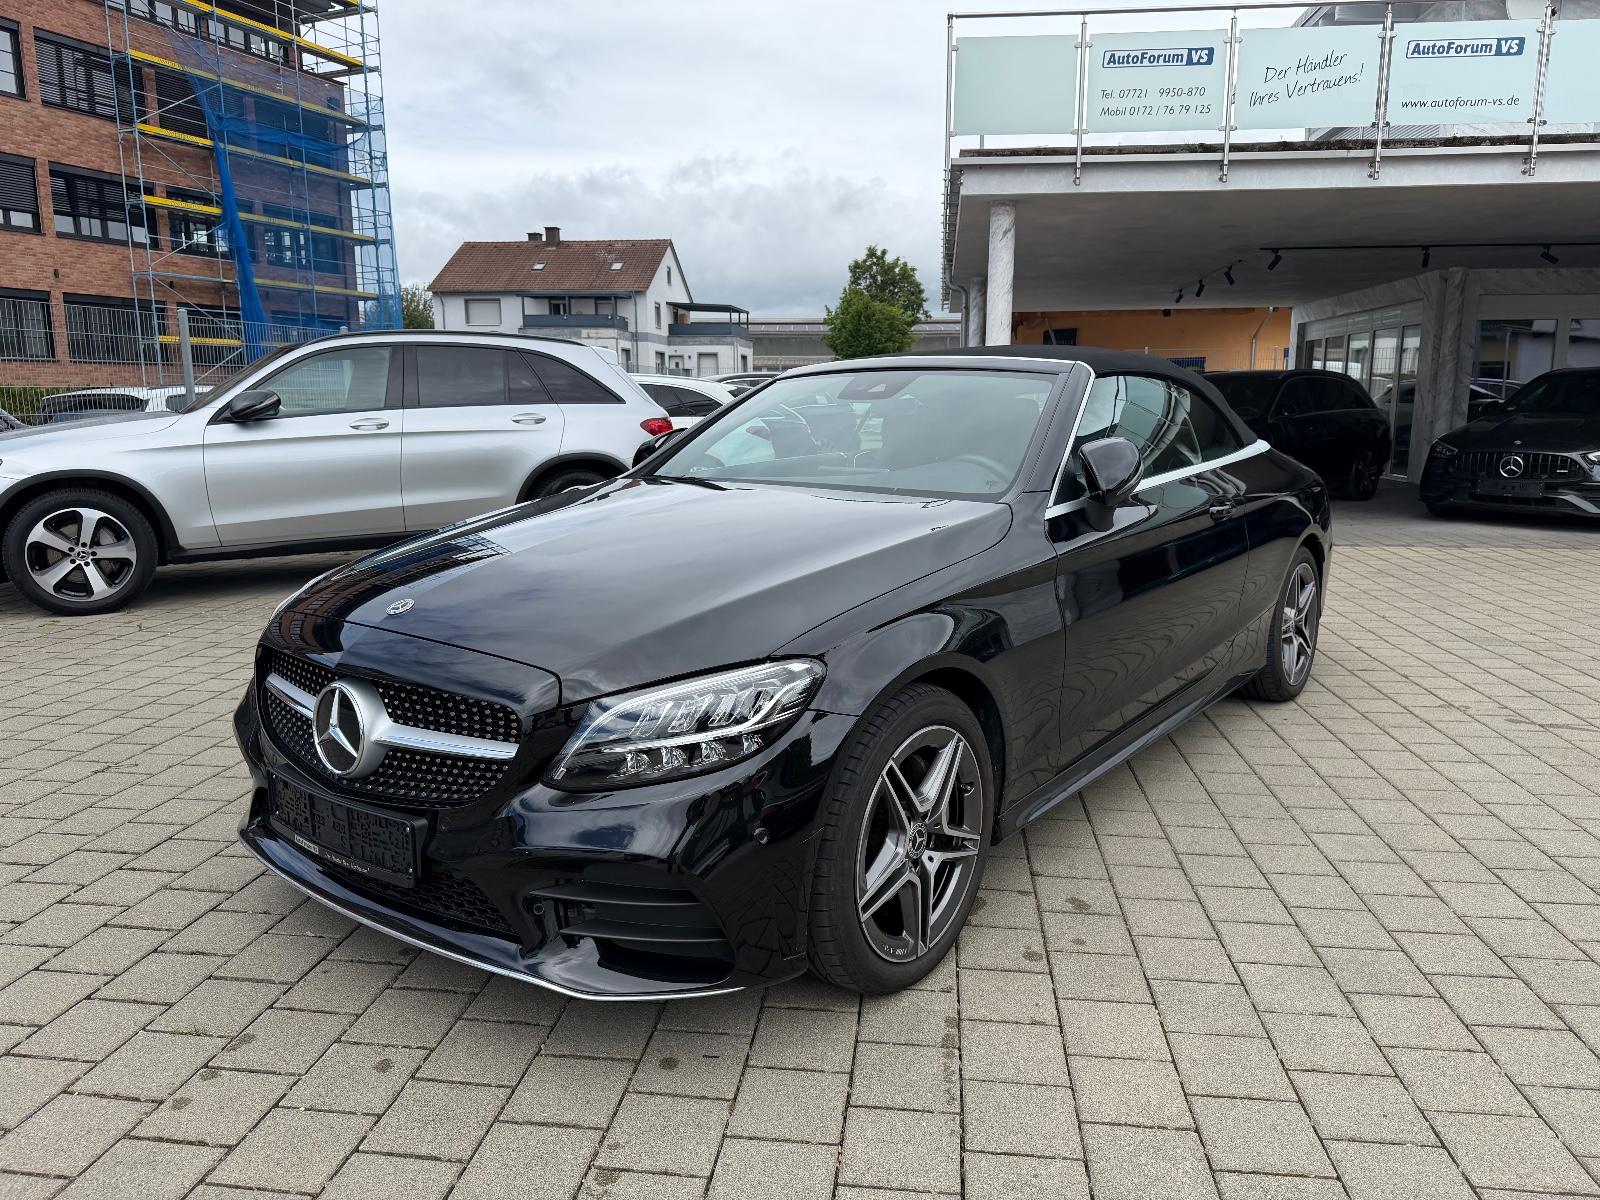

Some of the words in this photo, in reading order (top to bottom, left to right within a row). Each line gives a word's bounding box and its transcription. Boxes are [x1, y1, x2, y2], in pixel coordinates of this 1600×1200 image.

[1410, 41, 1493, 56] AutoForum
[1500, 39, 1520, 54] VS
[1106, 51, 1184, 65] AutoForum
[1190, 49, 1209, 63] VS
[1263, 66, 1292, 84] Der
[1100, 89, 1115, 99] Tel.
[1118, 88, 1148, 99] 07721
[1158, 86, 1206, 98] 9950-870
[1249, 91, 1280, 108] Ihres
[1286, 62, 1365, 99] Vertrauens!
[1401, 94, 1520, 109] www.autoforum-vs.de
[1099, 106, 1127, 117] Mobil
[1128, 105, 1153, 116] 0172
[1163, 105, 1175, 115] 76
[1194, 104, 1212, 114] 125
